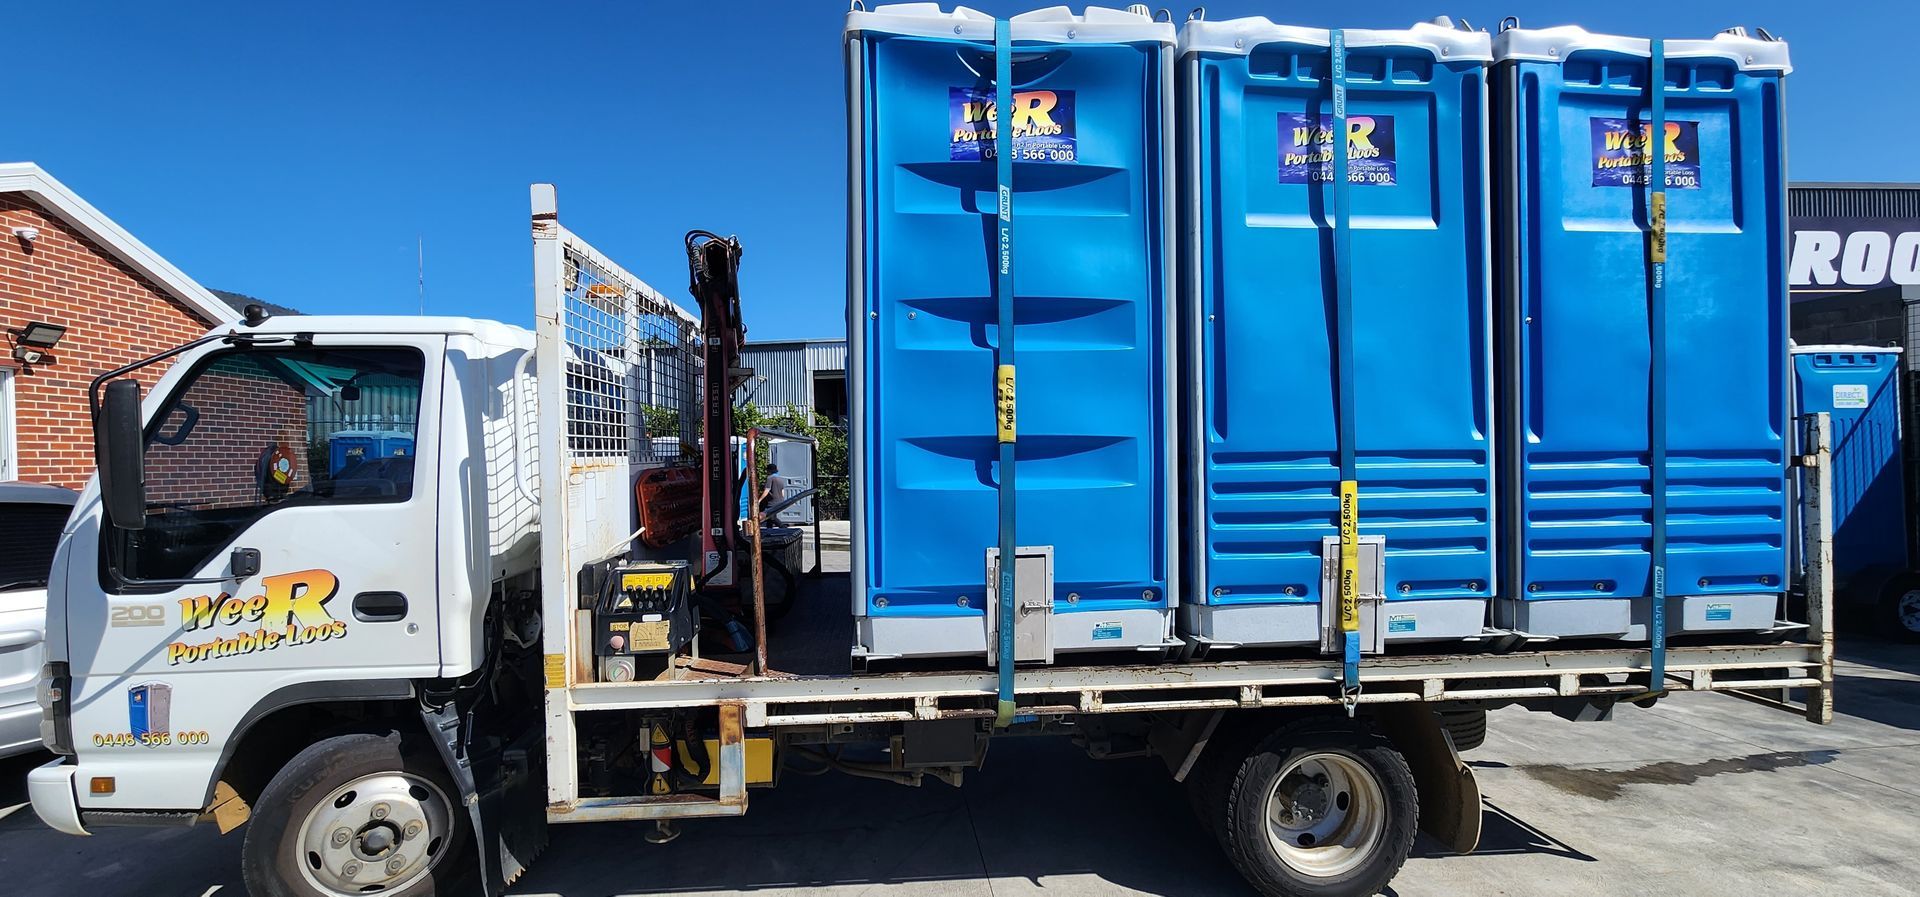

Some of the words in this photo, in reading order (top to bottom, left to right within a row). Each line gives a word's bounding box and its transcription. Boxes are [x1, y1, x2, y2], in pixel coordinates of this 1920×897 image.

[1336, 88, 1344, 115] GRUNT
[953, 127, 1024, 143] Portae
[1026, 122, 1062, 138] Loos
[1022, 149, 1046, 160] 566
[1050, 149, 1074, 161] 000
[1347, 146, 1380, 160] Loos
[1597, 152, 1653, 169] Portable
[1368, 172, 1390, 183] 000
[1622, 174, 1649, 185] 0448
[1675, 175, 1695, 186] 000
[1001, 189, 1009, 219] GRUNT
[1001, 227, 1009, 243] L/C
[1005, 377, 1014, 394] L/C
[1835, 391, 1862, 399] DIRECT
[1004, 395, 1014, 431] 2,500kg
[1342, 493, 1353, 528] 2,500kg
[1342, 529, 1351, 545] L/C
[111, 604, 165, 621] 200
[1343, 605, 1353, 622] L/C
[284, 620, 348, 647] Loos
[612, 623, 628, 631] STOP
[92, 732, 137, 748] 0448
[141, 731, 171, 746] 566
[177, 731, 210, 746] 000
